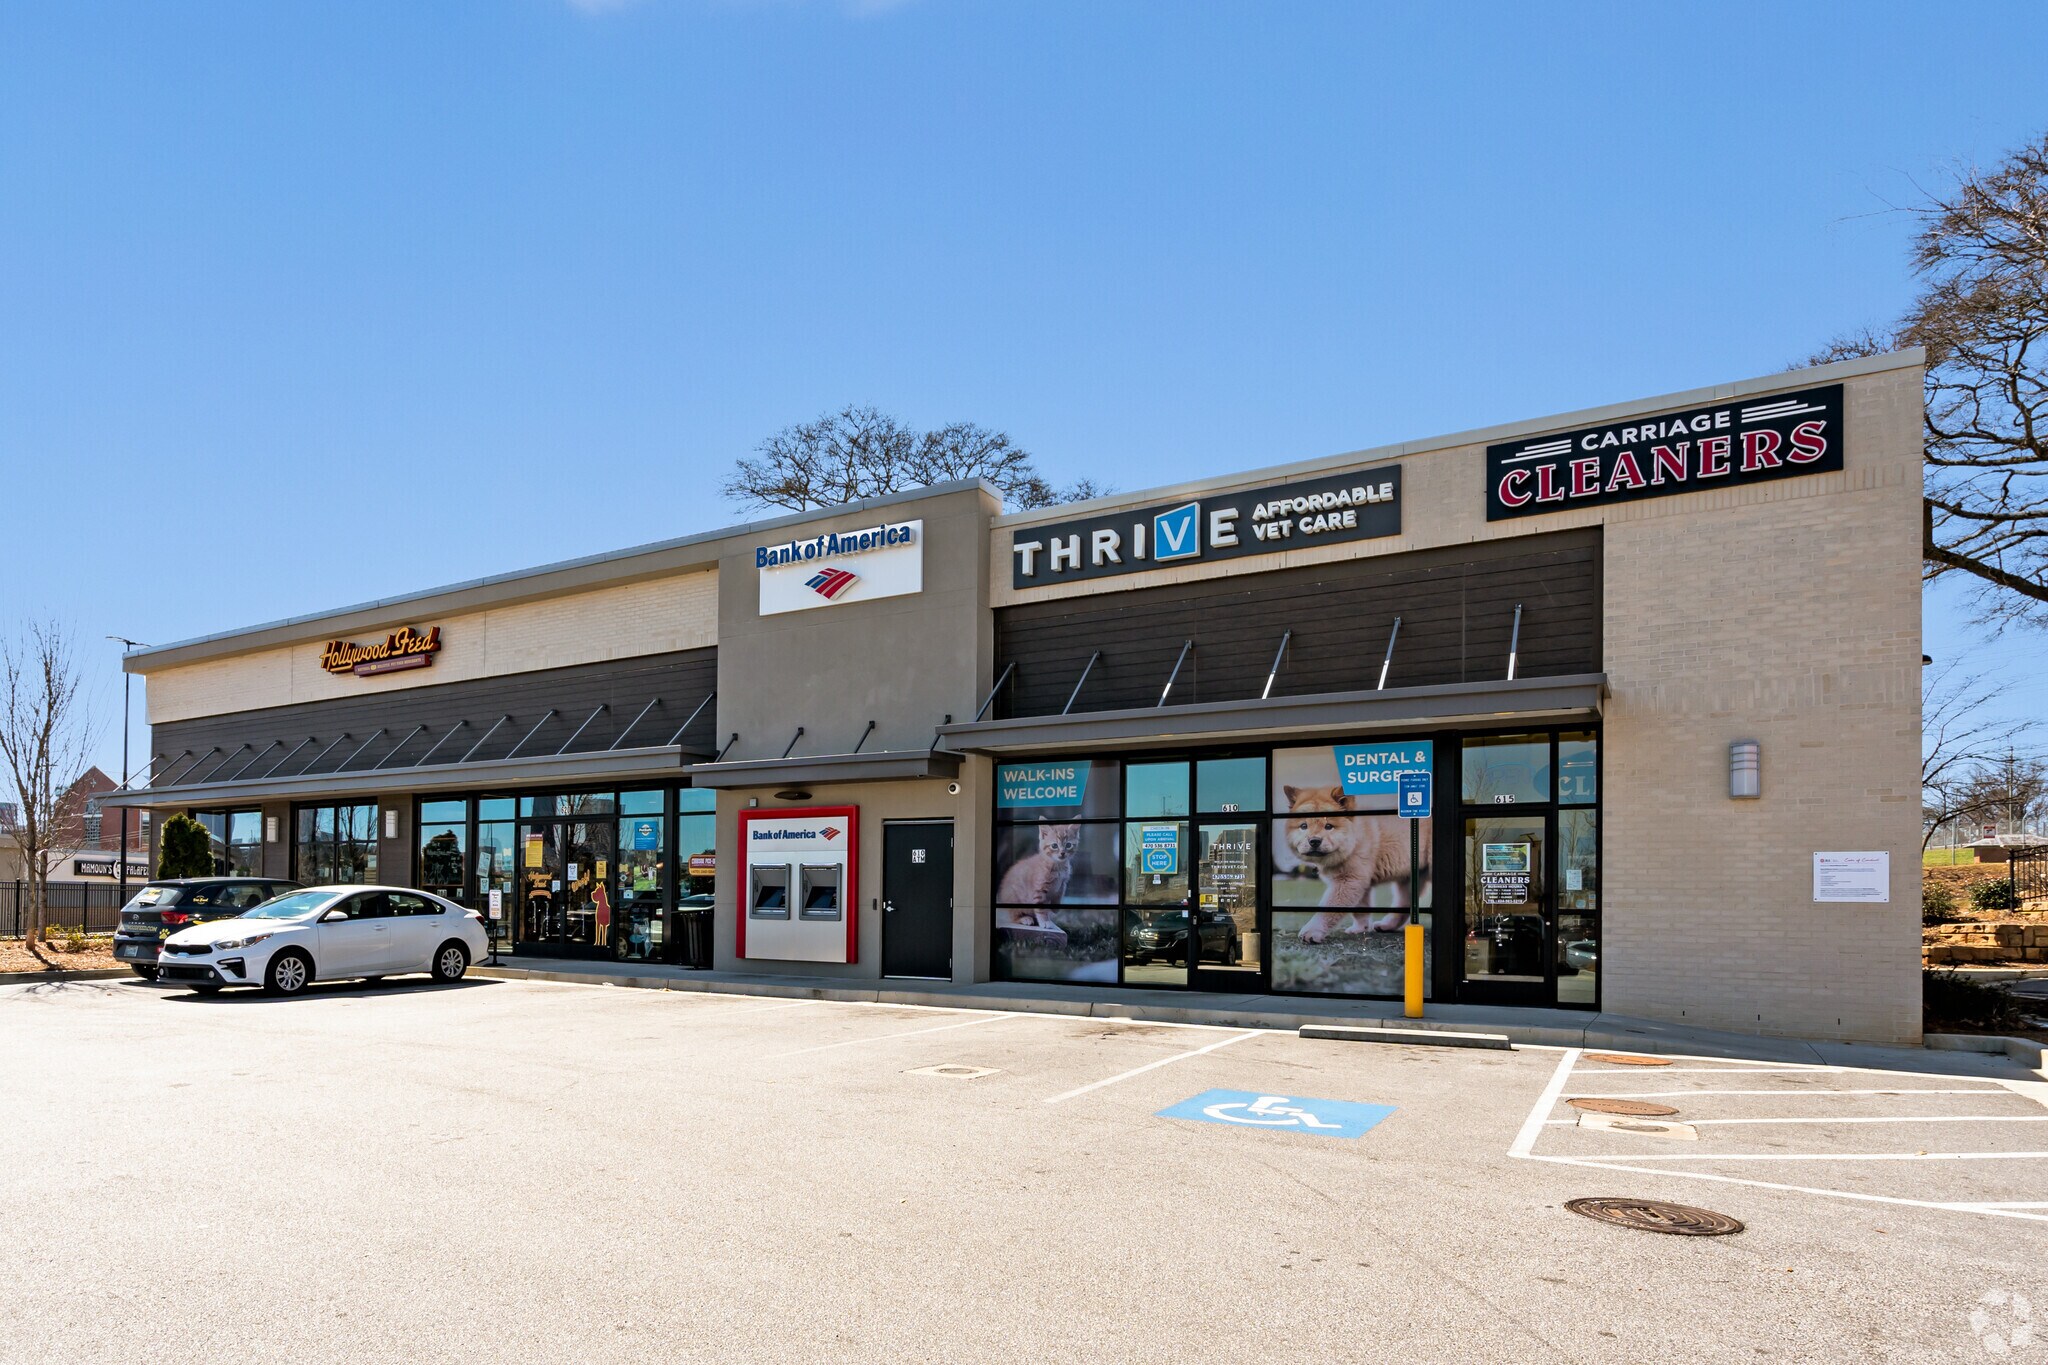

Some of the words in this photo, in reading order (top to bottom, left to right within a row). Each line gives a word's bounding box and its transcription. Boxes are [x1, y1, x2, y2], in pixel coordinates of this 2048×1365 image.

[1581, 410, 1731, 451] CARRIAGE
[1498, 420, 1827, 507] CLEANERS
[1252, 482, 1394, 521] AFFORDABLE
[1252, 521, 1293, 541] VET
[1298, 510, 1357, 535] CARE
[756, 540, 801, 569] Bank
[804, 535, 826, 560] of
[826, 524, 911, 556] America
[1013, 502, 1239, 576] THRIVE
[319, 634, 391, 673] Hollywood
[391, 626, 434, 656] Feed
[1344, 752, 1410, 766] DENTAL
[1414, 750, 1426, 763] &
[1003, 768, 1075, 783] WALK-INS
[1347, 769, 1426, 784] SURGE
[1003, 785, 1077, 800] WELCOME
[1559, 776, 1597, 796] CL
[1495, 795, 1515, 804] 615
[1222, 804, 1239, 812] 610
[752, 829, 773, 840] Bank
[773, 829, 783, 840] of
[782, 829, 817, 840] America
[81, 862, 113, 874] MAMOUN'S
[1480, 876, 1530, 884] CLEANERS
